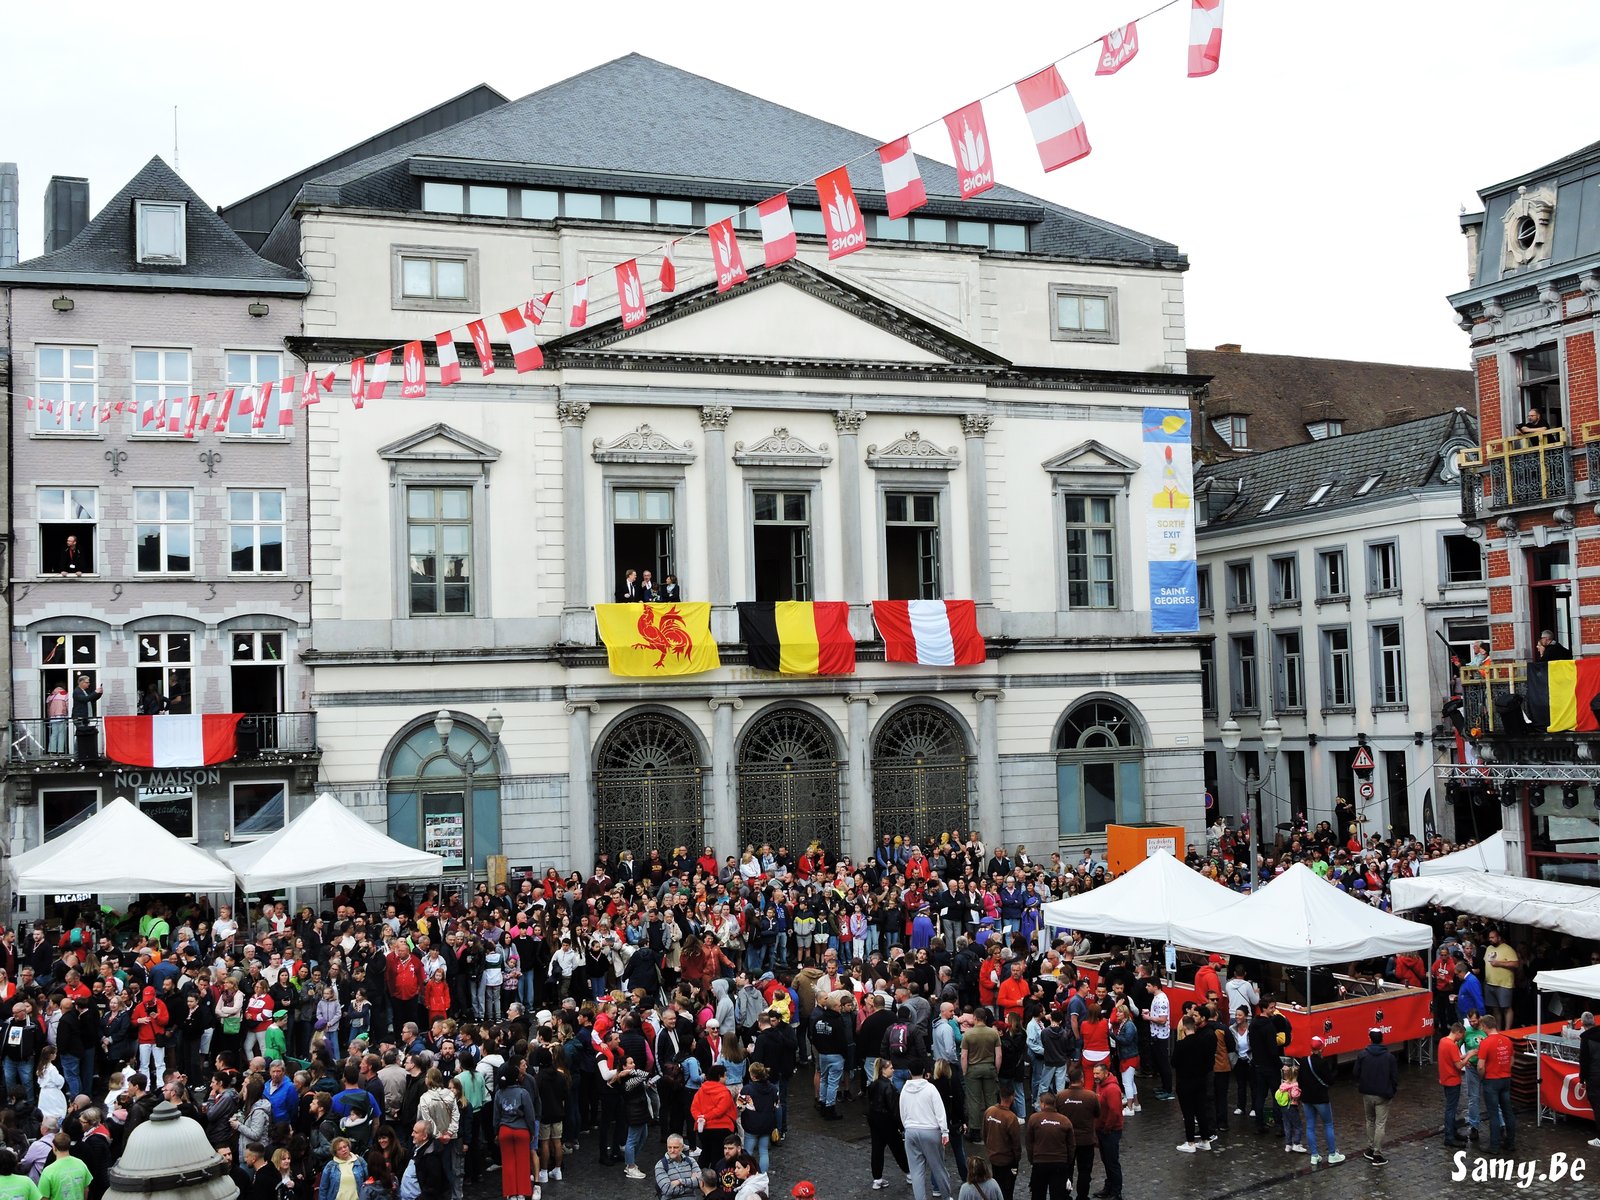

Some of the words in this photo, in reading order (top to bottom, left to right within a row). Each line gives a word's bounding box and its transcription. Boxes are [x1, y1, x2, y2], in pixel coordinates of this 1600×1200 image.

[1157, 520, 1185, 528] SORTIE
[1163, 531, 1181, 539] EXIT
[1169, 543, 1177, 555] 5
[1160, 587, 1189, 596] SAINT-
[1154, 596, 1196, 605] GEORGES
[114, 771, 142, 788] NO
[148, 769, 221, 787] MAISON
[54, 891, 92, 904] BACARDI
